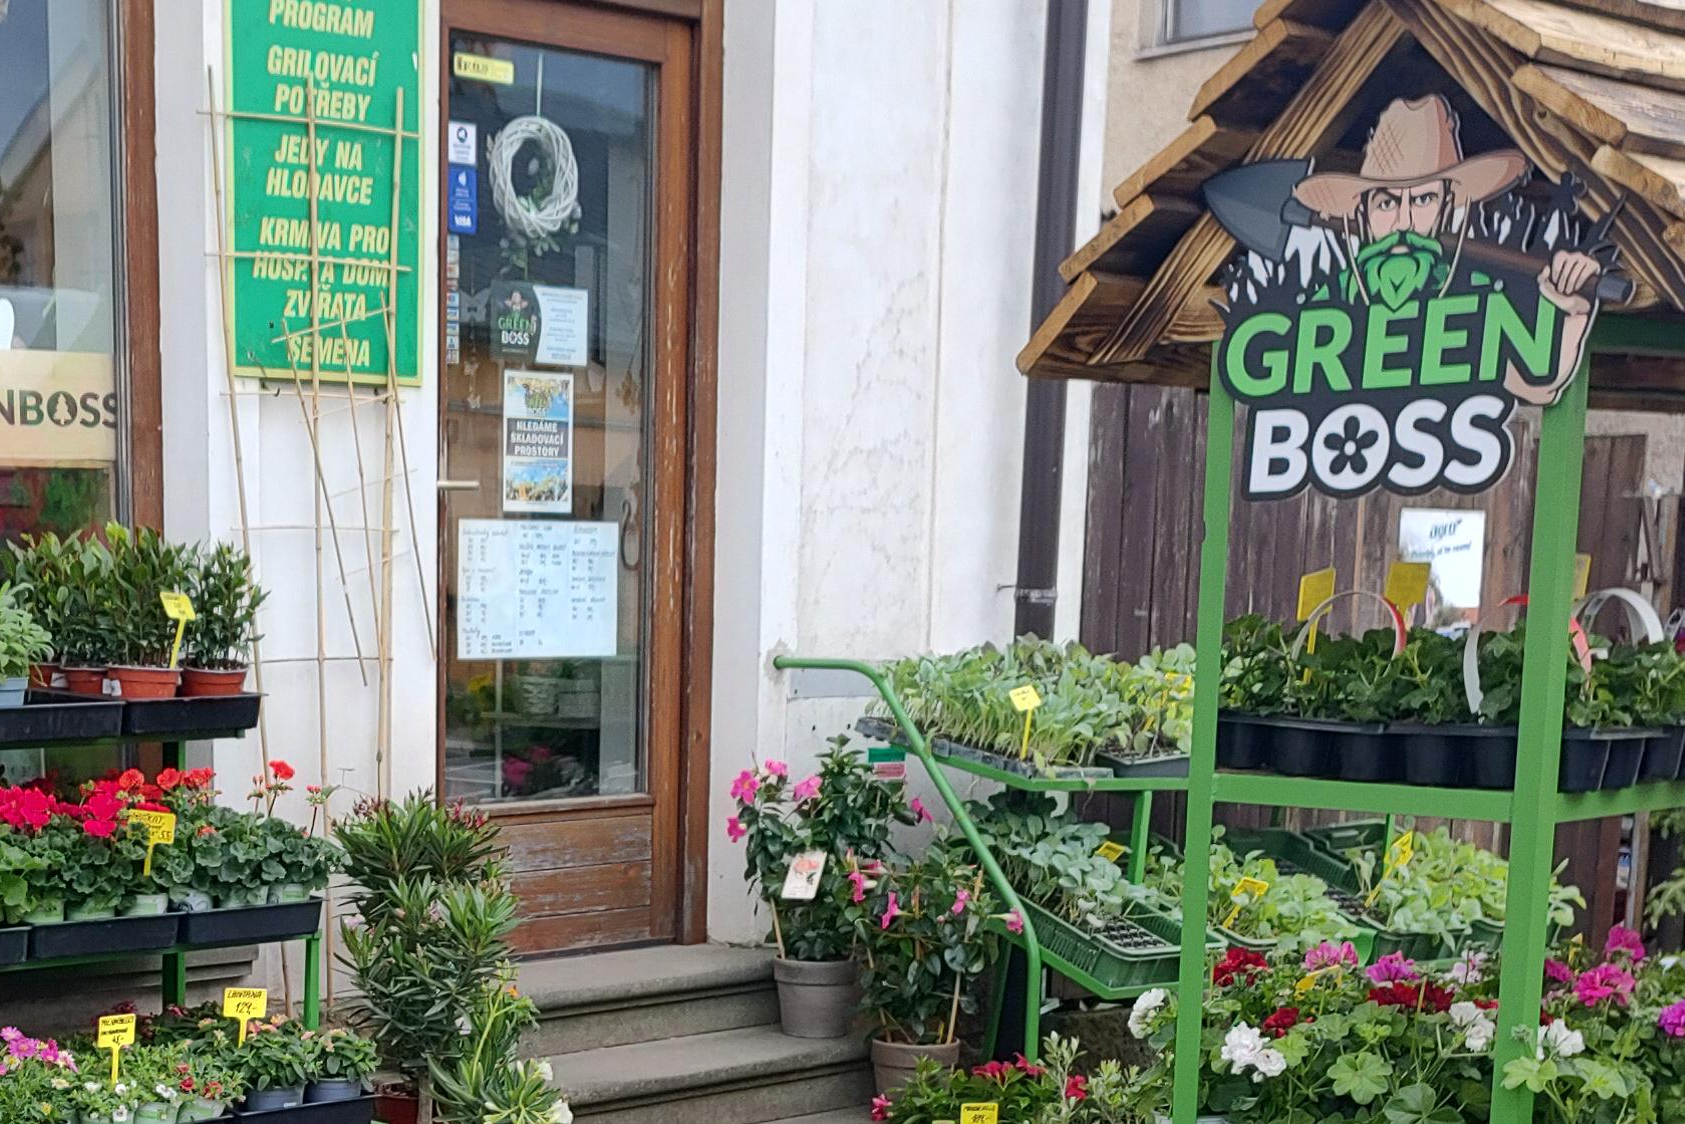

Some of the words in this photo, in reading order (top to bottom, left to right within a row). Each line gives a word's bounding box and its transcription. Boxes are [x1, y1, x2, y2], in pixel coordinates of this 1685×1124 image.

[268, 0, 375, 39] PROGRAM
[267, 45, 380, 87] GRILOVACÍ
[334, 141, 363, 171] NA
[349, 224, 390, 255] PRO
[320, 256, 334, 284] A
[283, 282, 366, 320] ZVŘATA
[498, 316, 535, 332] GREEN
[501, 330, 530, 346] BOSS
[288, 336, 370, 366] SEMENA
[1226, 294, 1556, 398] GREEN
[510, 431, 564, 446] SKLADOVACÍ
[516, 419, 558, 433] HLEDÁME
[514, 445, 560, 458] PROSTORY
[1248, 395, 1506, 493] BOSS
